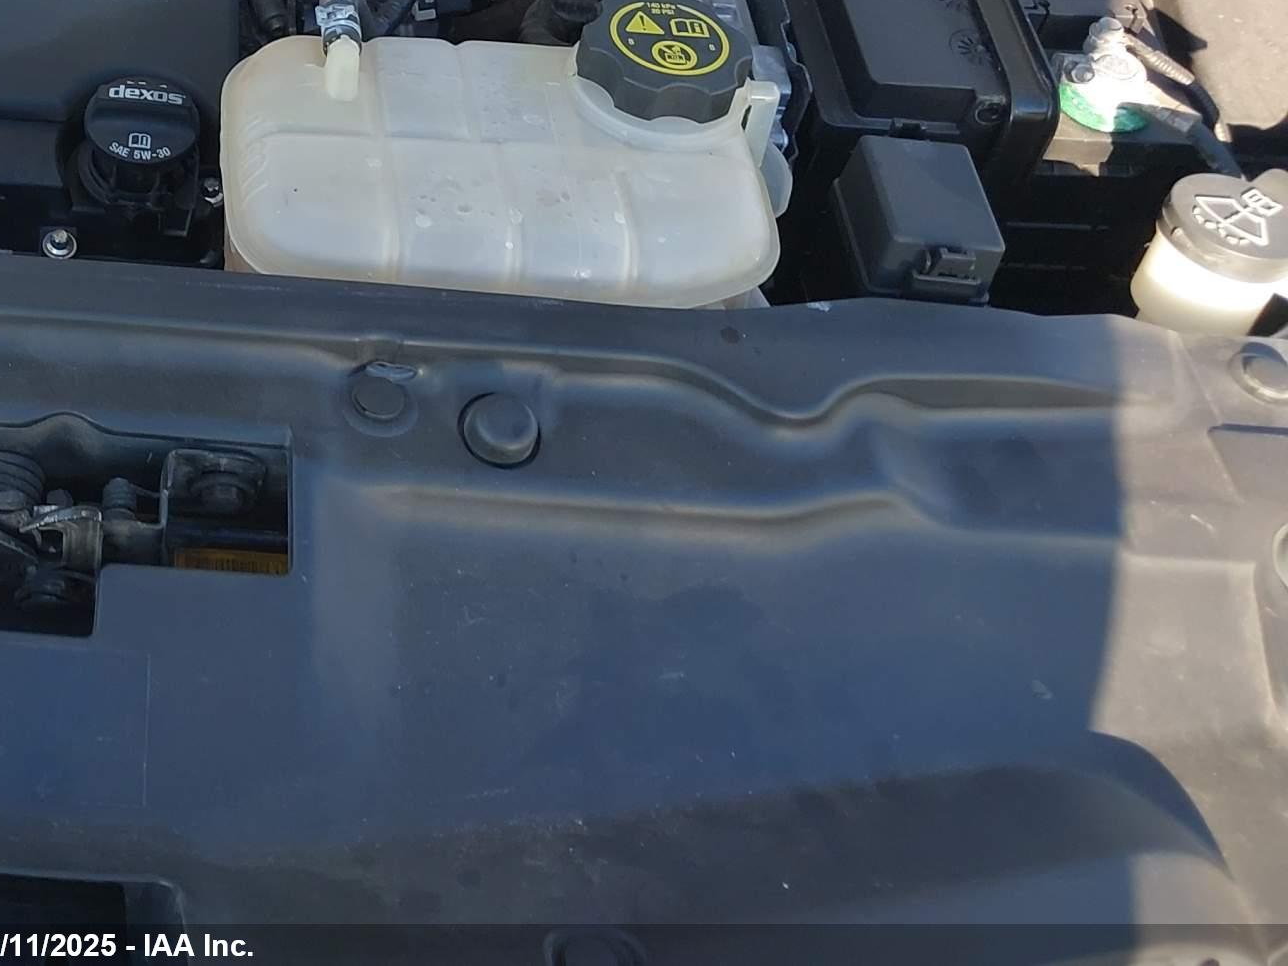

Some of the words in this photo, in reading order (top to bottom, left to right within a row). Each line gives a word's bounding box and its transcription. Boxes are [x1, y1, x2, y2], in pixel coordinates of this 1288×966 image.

[108, 85, 184, 105] dexos
[109, 142, 130, 158] SAE
[133, 146, 172, 160] 5W-30
